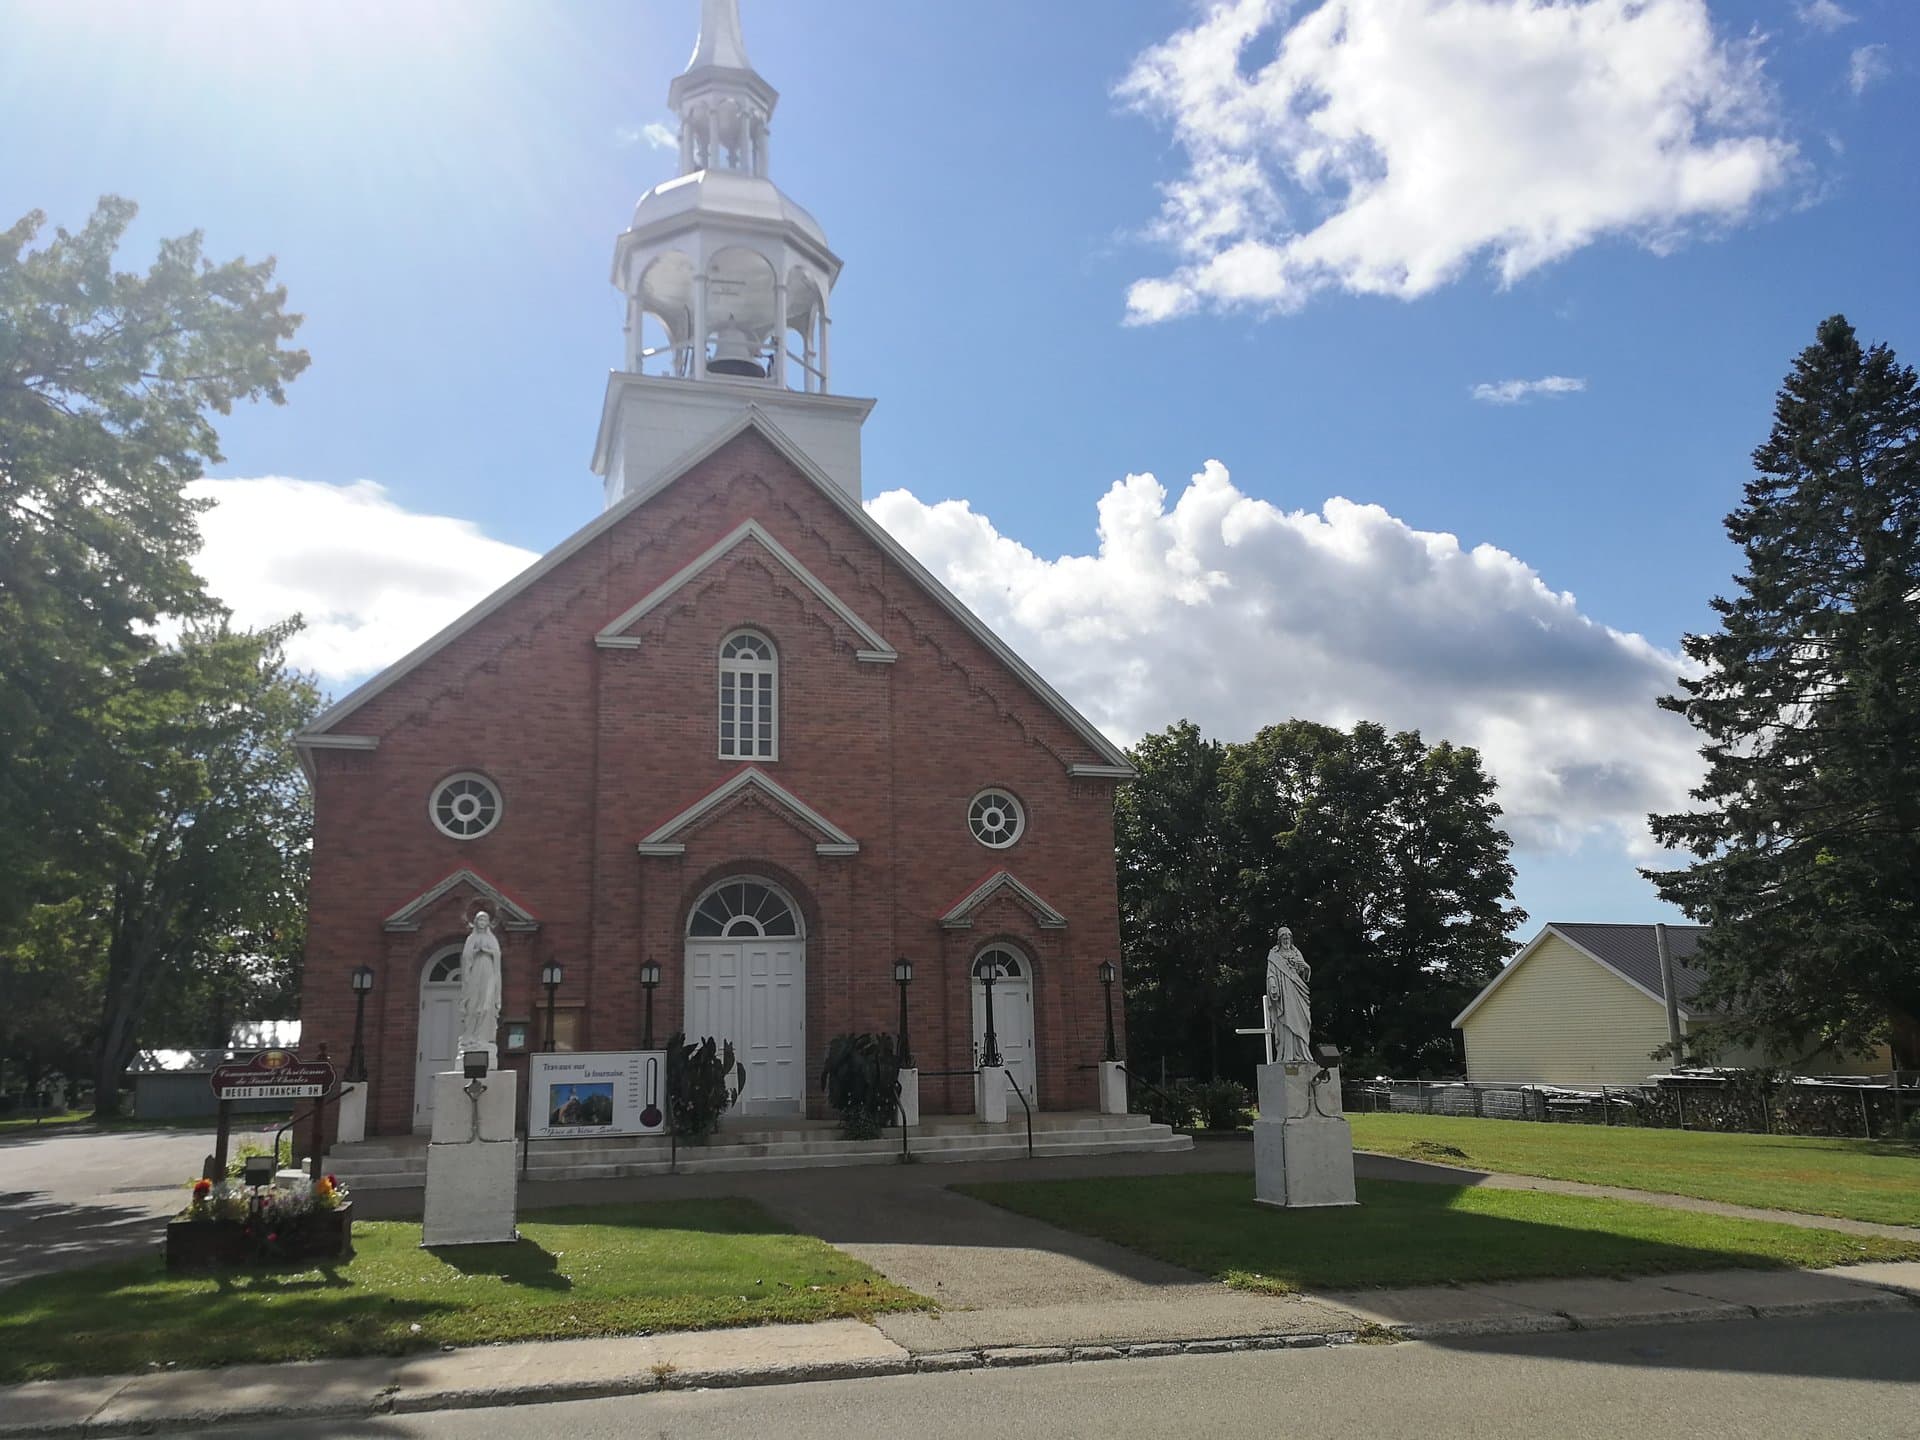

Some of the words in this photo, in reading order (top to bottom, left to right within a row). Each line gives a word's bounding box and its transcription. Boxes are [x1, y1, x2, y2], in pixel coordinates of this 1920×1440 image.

[543, 1063, 572, 1071] Travaux
[225, 1088, 252, 1097] MESSE
[259, 1087, 300, 1096] DIMANCHE
